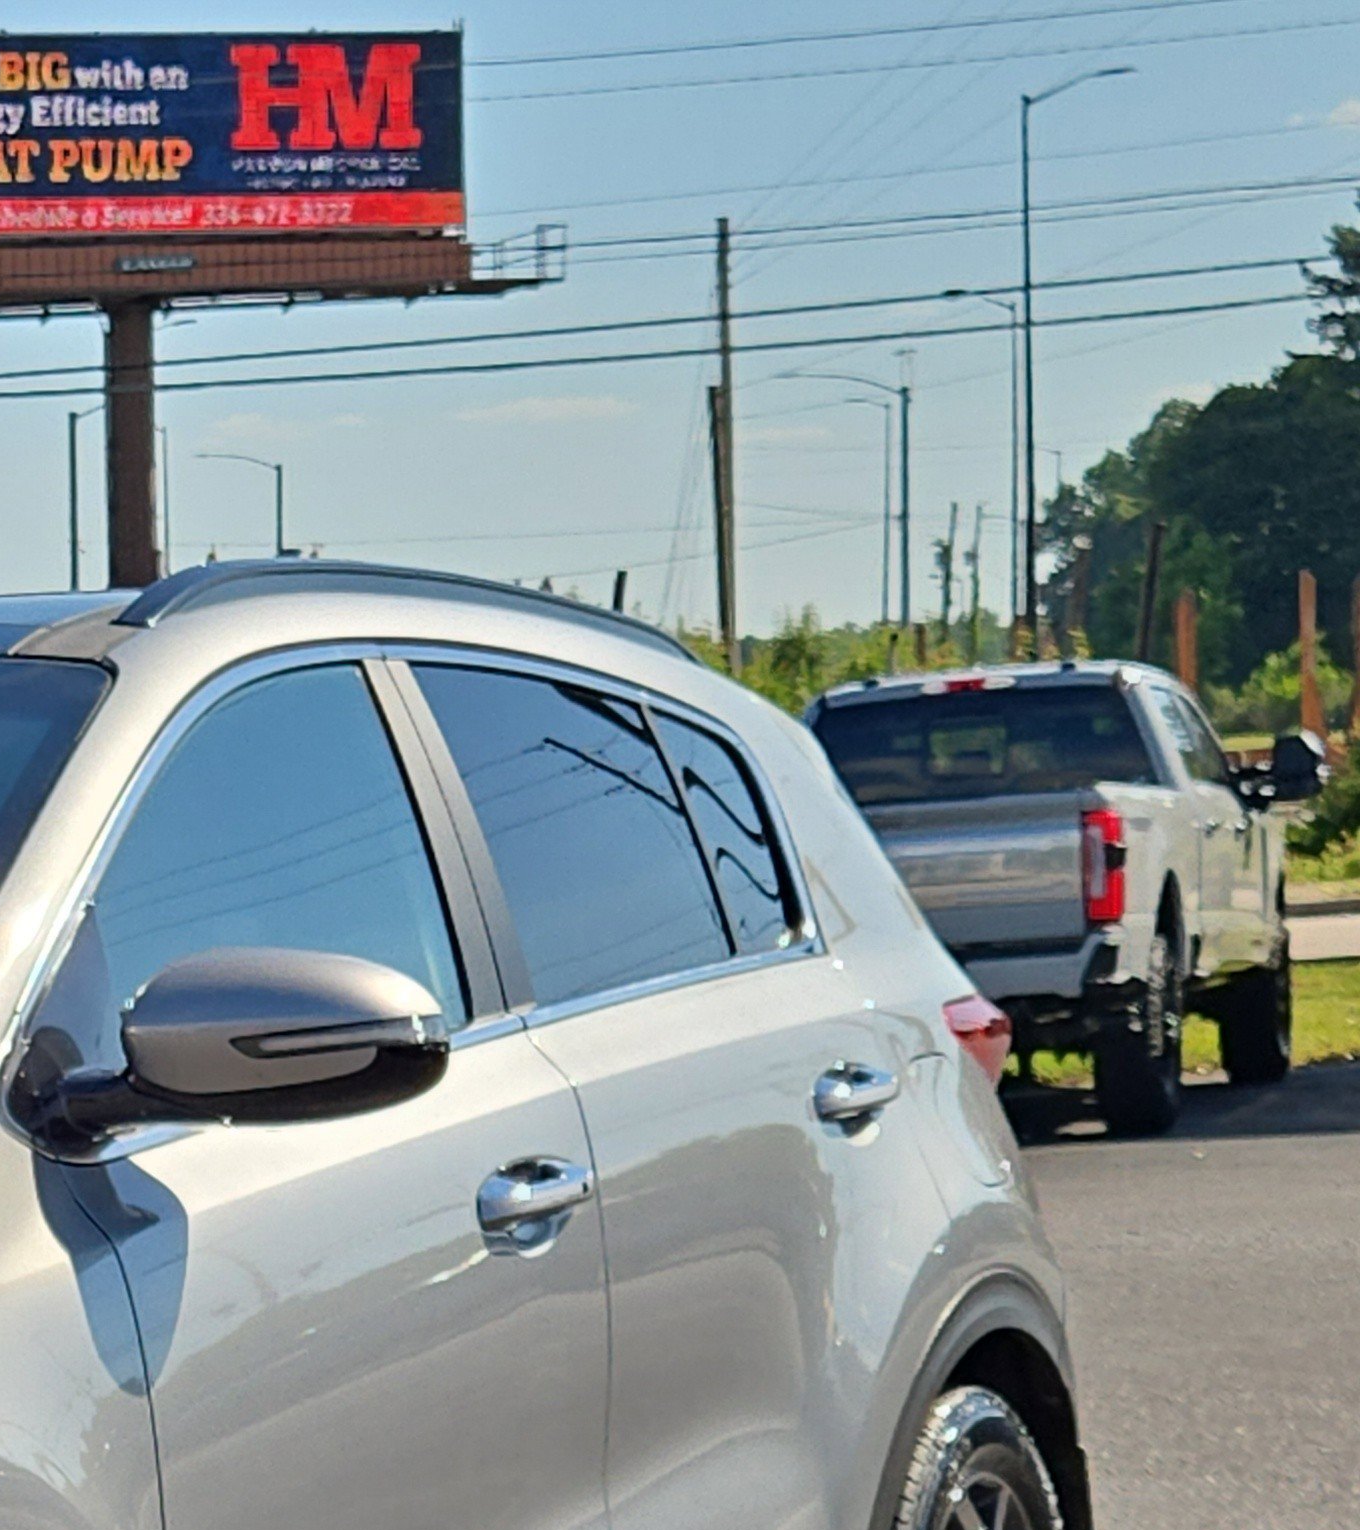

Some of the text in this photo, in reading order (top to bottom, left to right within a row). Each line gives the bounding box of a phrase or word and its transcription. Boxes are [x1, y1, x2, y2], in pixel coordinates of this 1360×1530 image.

[73, 59, 145, 91] with
[148, 64, 189, 90] an
[30, 96, 160, 127] Efficient
[230, 43, 423, 151] HM
[48, 136, 194, 183] PUMP
